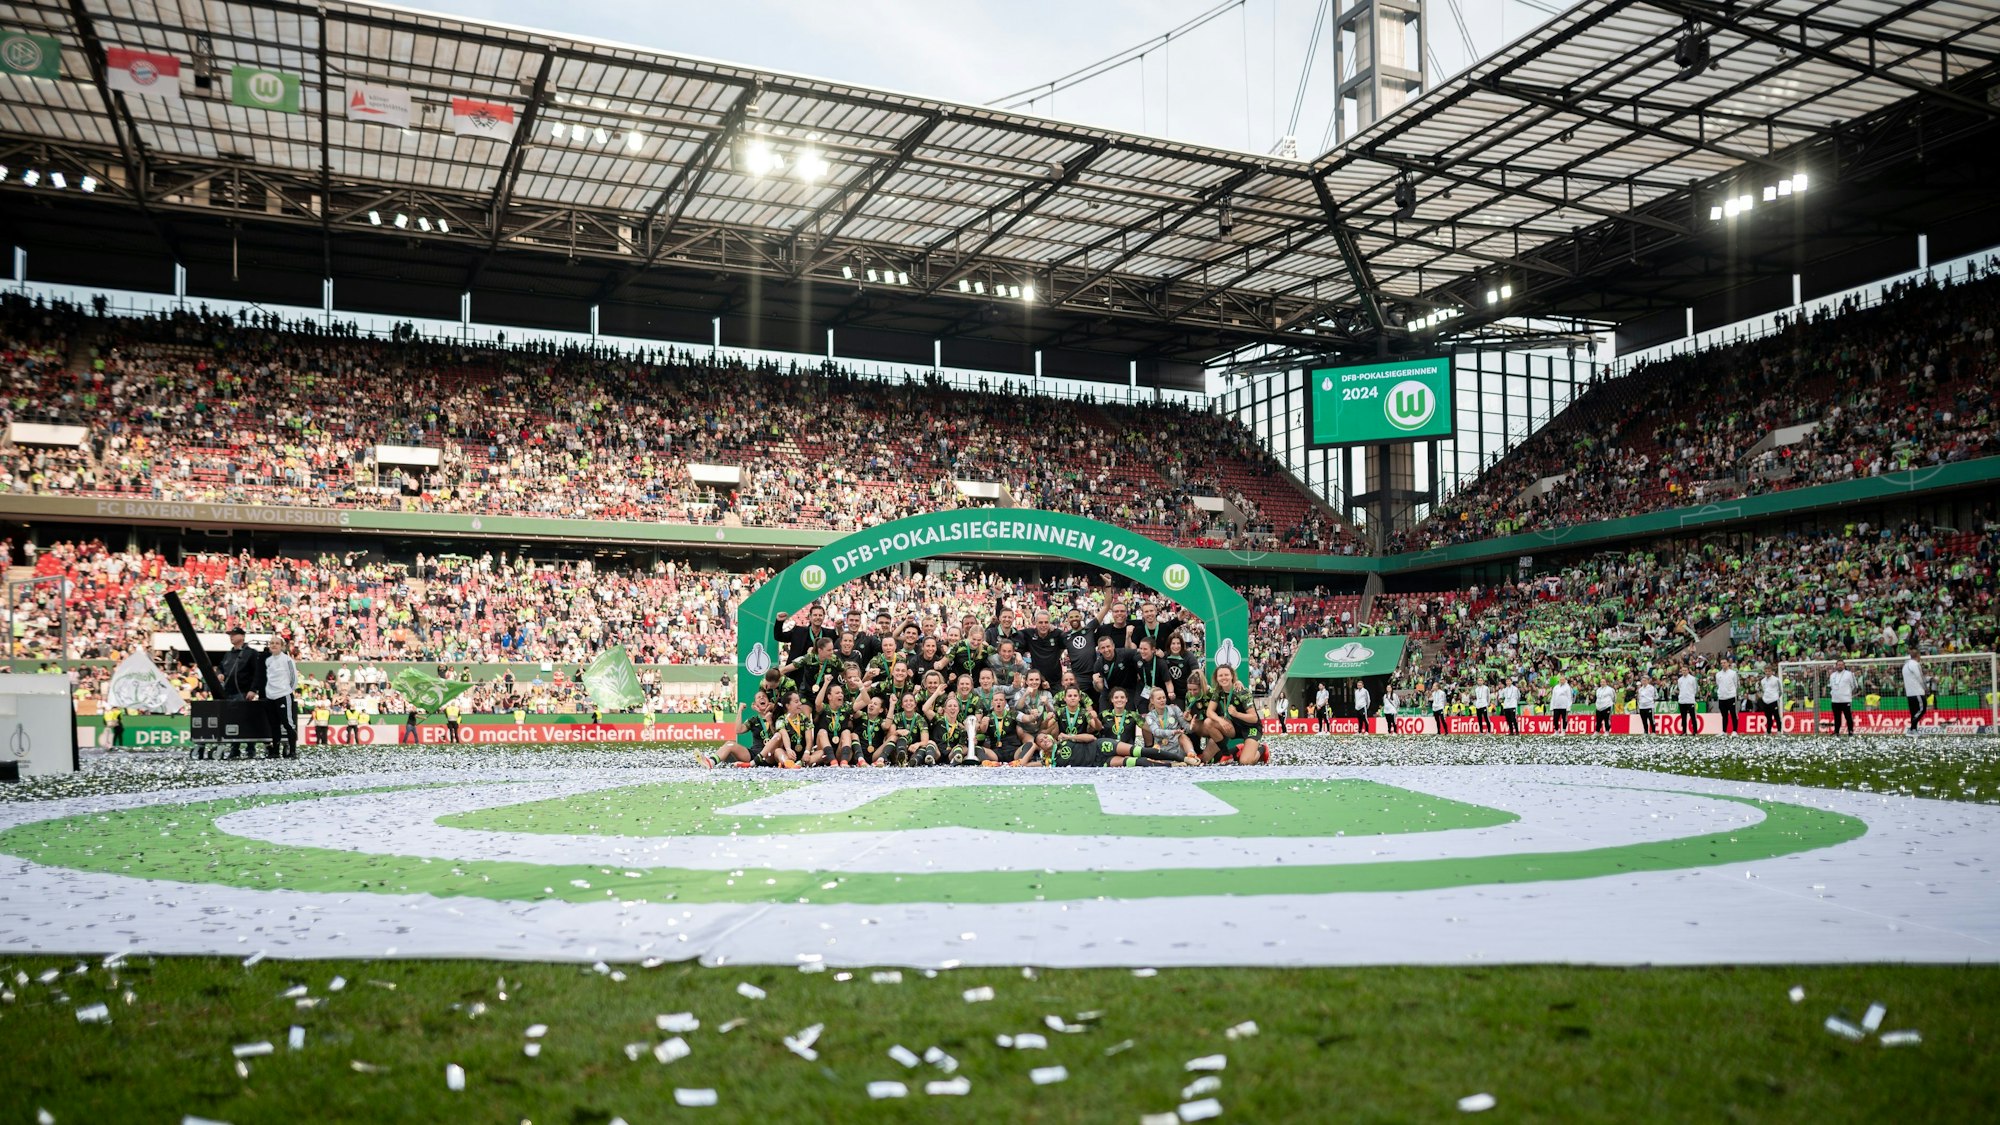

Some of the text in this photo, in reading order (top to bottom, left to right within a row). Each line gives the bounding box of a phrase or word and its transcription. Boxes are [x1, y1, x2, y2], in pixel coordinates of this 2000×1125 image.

[1341, 366, 1438, 382] DFB-POKALSIEGERINNEN
[1342, 386, 1379, 401] 2024
[96, 502, 121, 515] FC
[125, 503, 196, 518] BAYERN
[211, 507, 243, 521] VFL
[243, 508, 350, 525] WOLFSBURG
[831, 520, 1153, 574] DFB-POKALSIEGERINNEN 2024
[1392, 717, 1425, 734] RGO
[1499, 717, 1536, 733] wil’s
[1838, 726, 1903, 735] FLERALARM
[479, 725, 537, 743] macht
[543, 724, 636, 742] Versichern
[1101, 741, 1114, 753] 23
